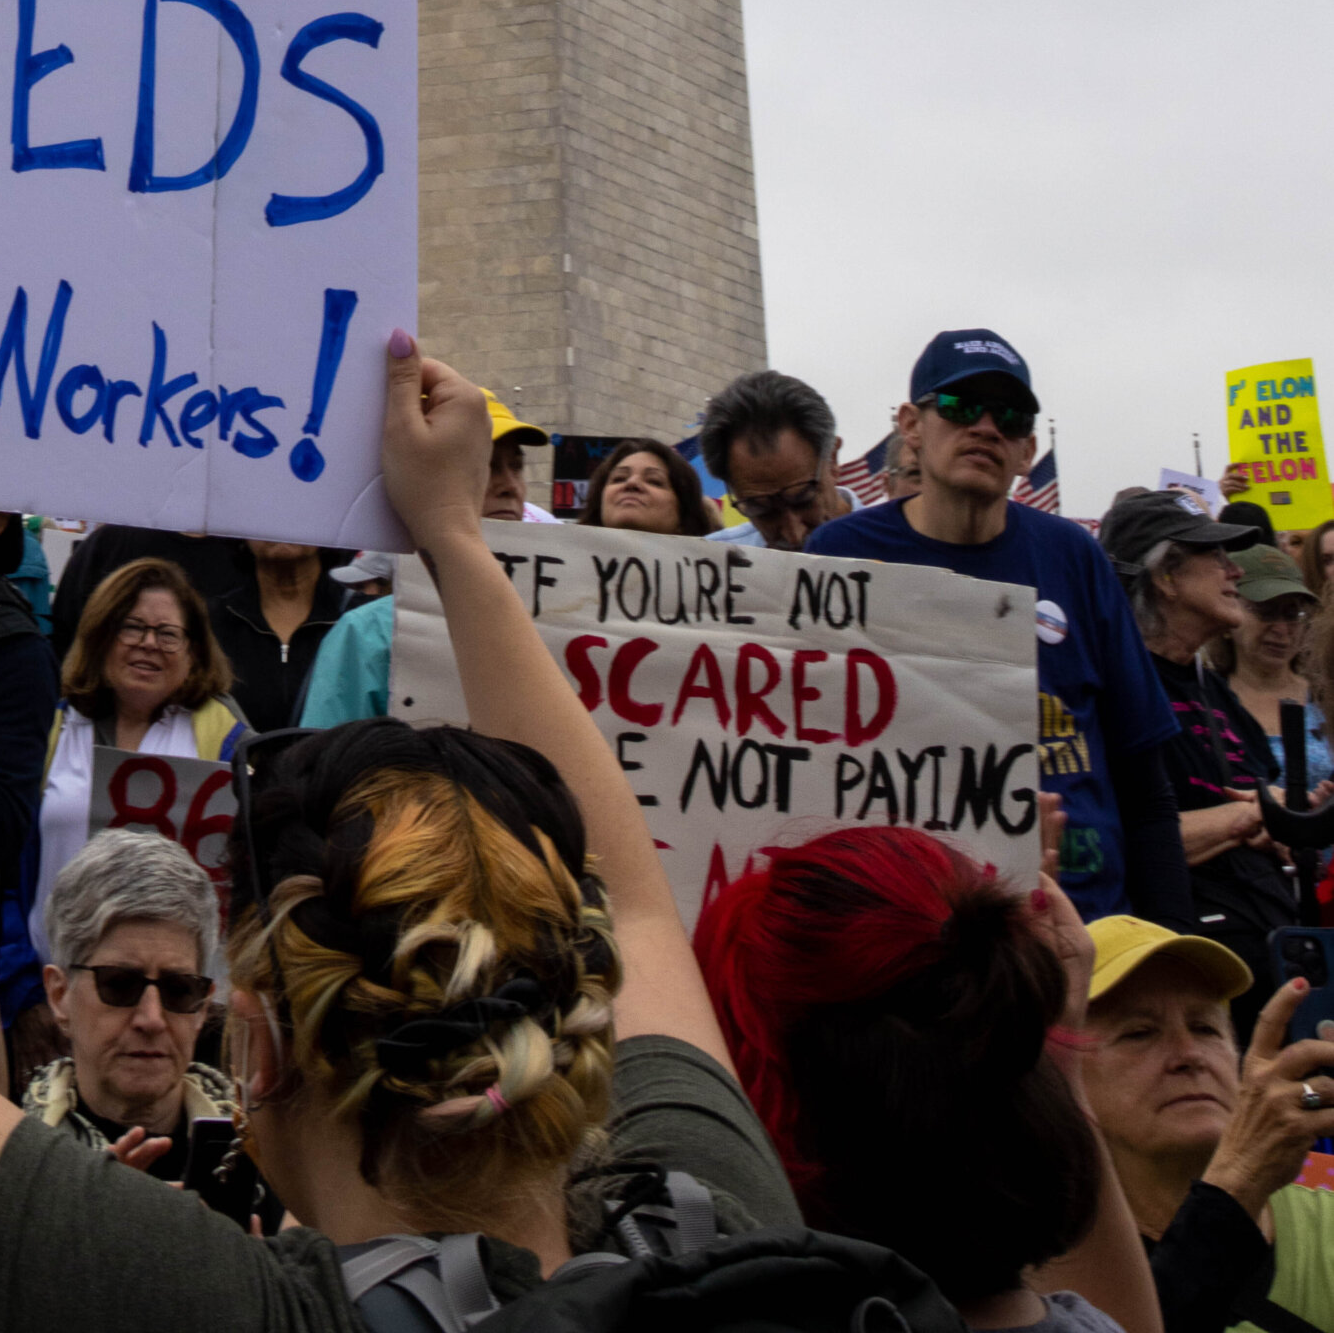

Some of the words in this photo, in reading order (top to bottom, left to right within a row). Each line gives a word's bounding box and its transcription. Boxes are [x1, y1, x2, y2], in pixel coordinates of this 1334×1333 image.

[1257, 376, 1315, 401] ELON
[1239, 404, 1292, 429] AND
[1259, 431, 1308, 454] THE
[1237, 458, 1318, 483] FELON
[592, 549, 756, 625] YOU'RE
[788, 567, 872, 631] NOT
[565, 635, 898, 748] SCARED
[680, 738, 811, 814] NOT
[835, 743, 1038, 837] PAYING
